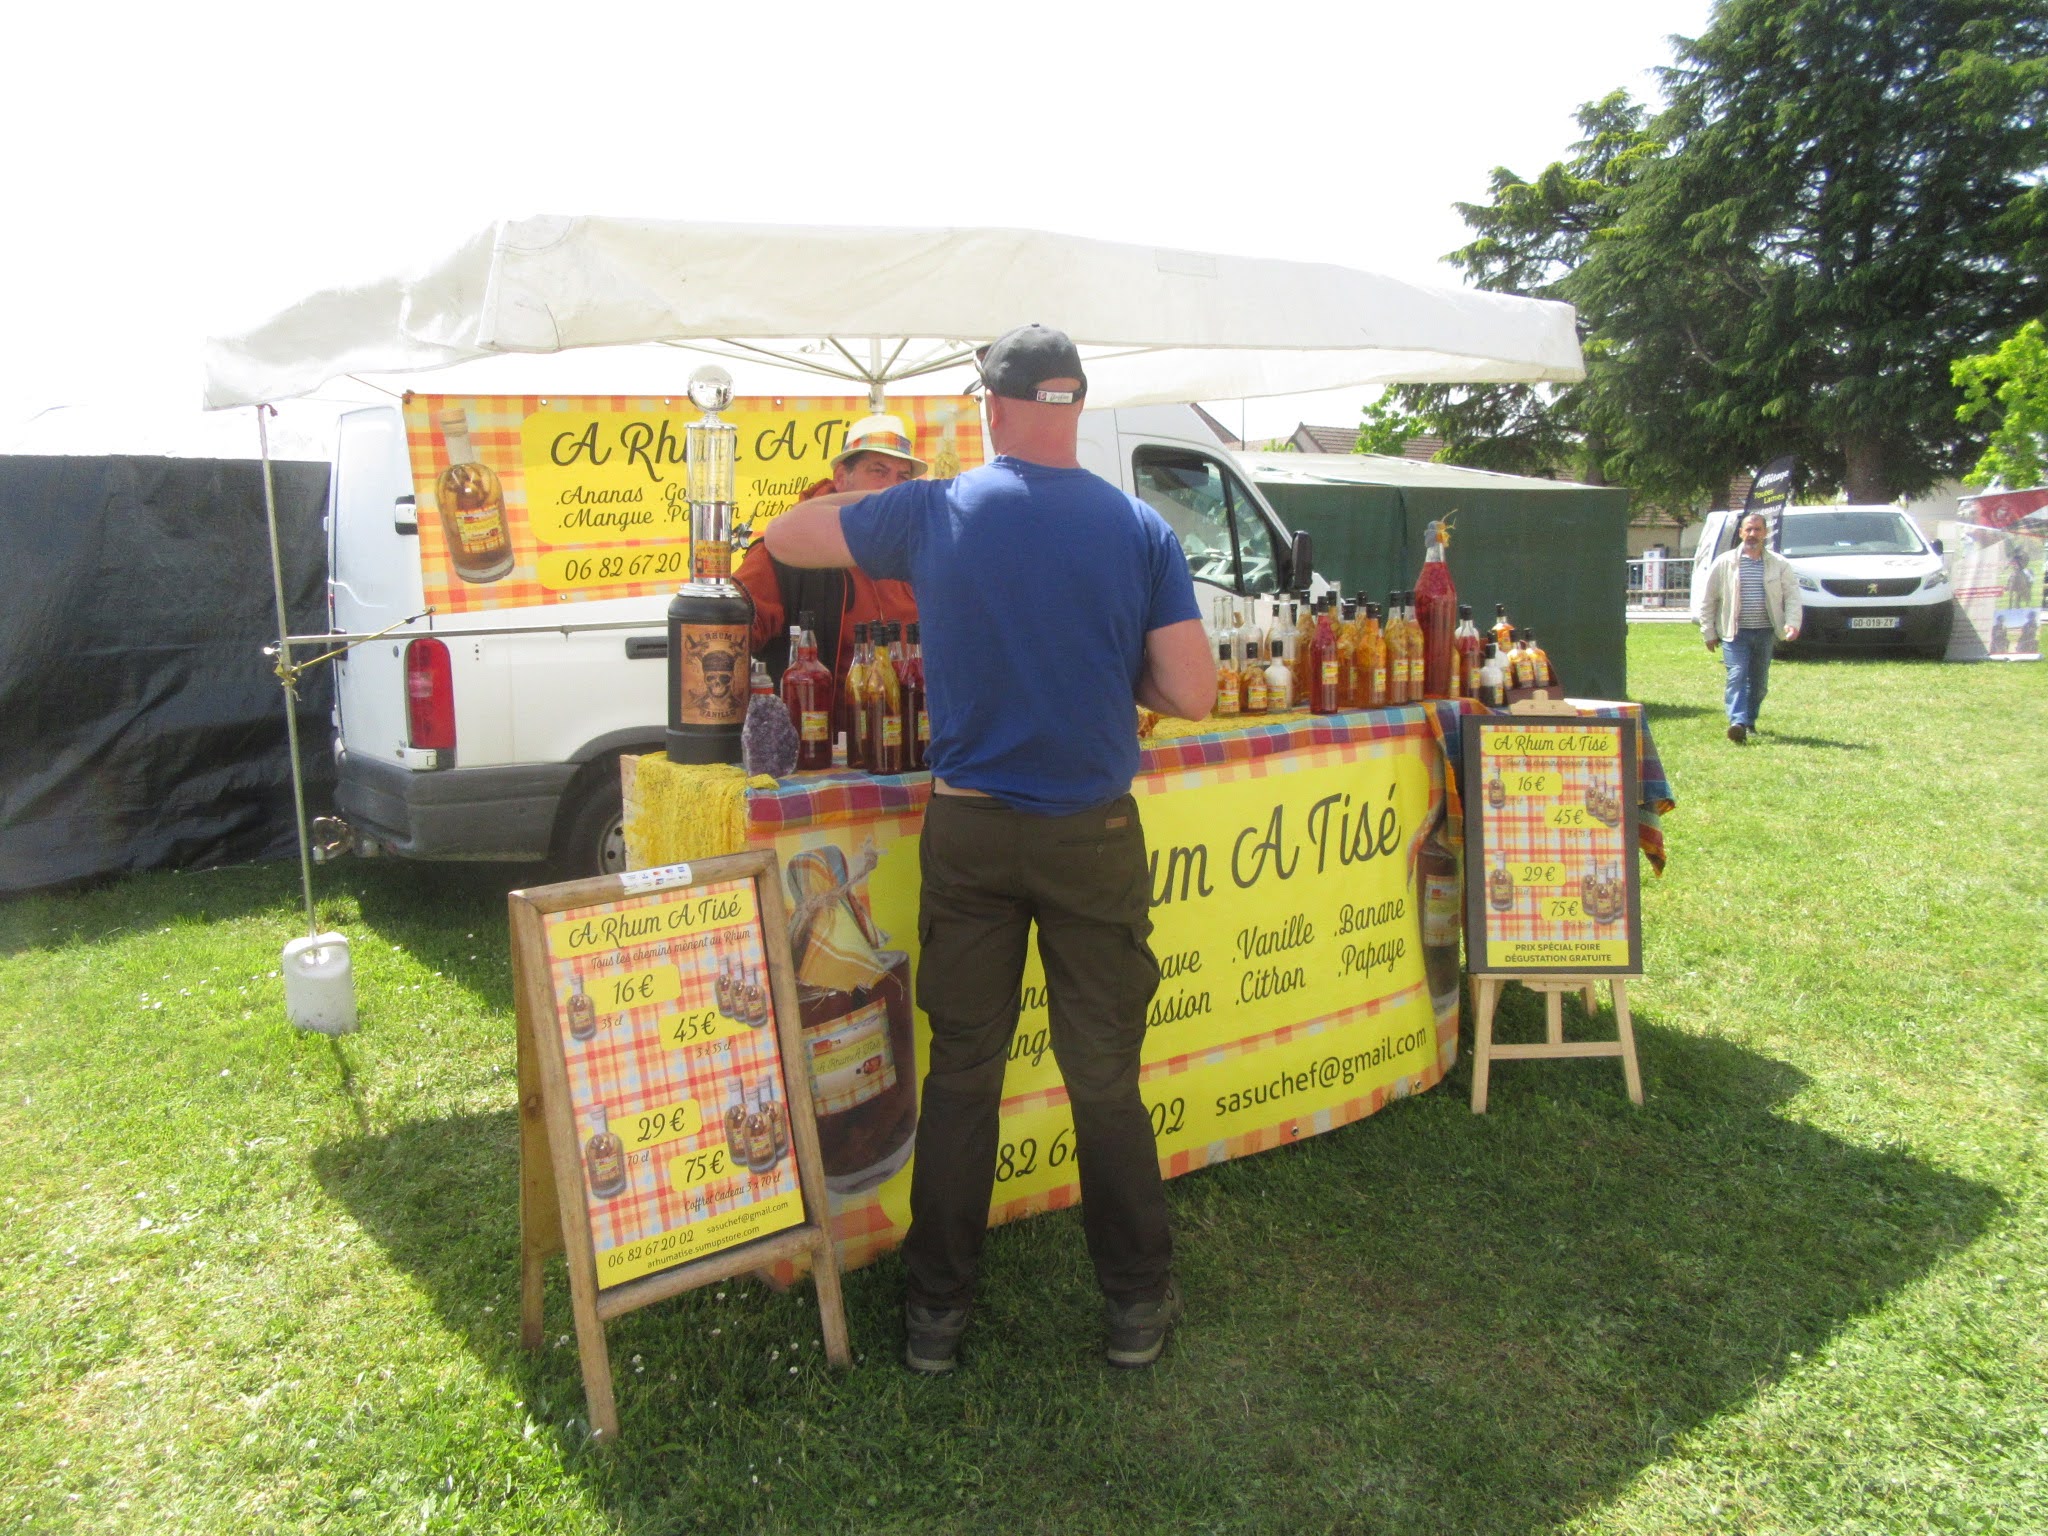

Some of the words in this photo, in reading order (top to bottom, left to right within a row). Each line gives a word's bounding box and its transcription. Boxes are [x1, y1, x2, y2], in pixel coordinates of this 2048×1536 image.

[551, 421, 612, 466] A
[755, 420, 808, 461] A
[814, 419, 850, 460] Ti
[565, 559, 592, 581] 06
[598, 557, 623, 578] 82
[1493, 735, 1513, 751] A
[1515, 735, 1554, 757] Rhum
[1558, 736, 1577, 751] A
[1579, 736, 1609, 752] Tisé
[1149, 843, 1214, 908] um
[1231, 804, 1300, 889] A
[1307, 782, 1401, 875] Tisé
[569, 921, 598, 948] A
[601, 914, 661, 949] Rhum
[668, 903, 695, 929] A
[698, 894, 742, 924] Tisé
[591, 957, 614, 969] Tous
[615, 951, 631, 964] les
[633, 946, 672, 960] chemins
[674, 936, 709, 953] mènent
[709, 936, 722, 946] au
[724, 929, 751, 945] Rhum
[1504, 953, 1567, 963] DÉGUSTATION
[1568, 954, 1612, 962] GRATUITE
[1538, 941, 1573, 951] SPÉCIAL
[1575, 943, 1601, 951] FOIRE
[601, 1016, 612, 1029] 35
[995, 1138, 1038, 1183] 82
[1215, 1027, 1427, 1117] sasuchef@gmail.com
[627, 1154, 639, 1166] 70
[684, 1195, 713, 1212] Coffret
[715, 1185, 744, 1202] Cadeau
[760, 1176, 772, 1188] 70
[608, 1251, 624, 1268] 06
[628, 1247, 642, 1262] 82
[679, 1229, 695, 1245] 02
[706, 1201, 789, 1234] sasuchef@gmail.com
[647, 1225, 760, 1269] arhumatise.sumupstore.com
